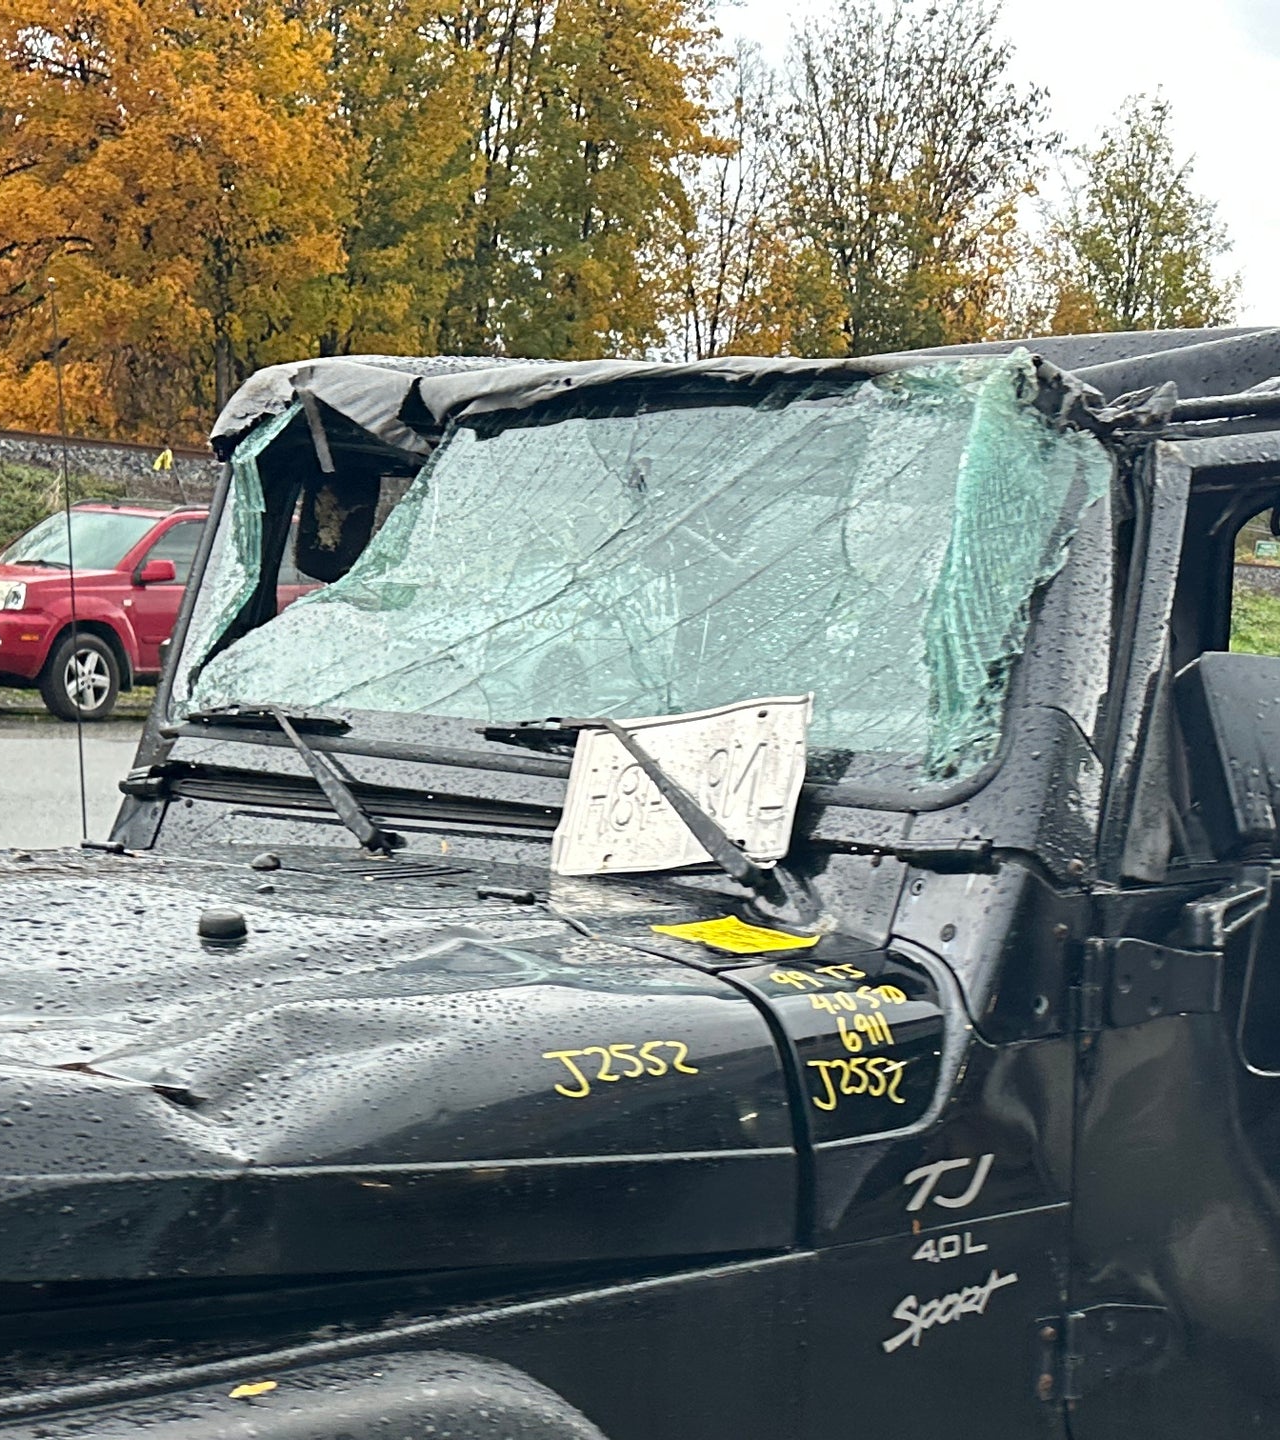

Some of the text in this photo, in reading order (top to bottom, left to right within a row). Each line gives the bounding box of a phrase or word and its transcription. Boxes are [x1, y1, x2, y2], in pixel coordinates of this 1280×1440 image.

[769, 963, 866, 990] 99 TJ
[808, 990, 857, 1014] 4.0
[836, 1011, 895, 1052] 6911
[542, 1040, 699, 1098] J2552
[806, 1057, 907, 1111] J2552
[903, 1153, 995, 1211] TJ
